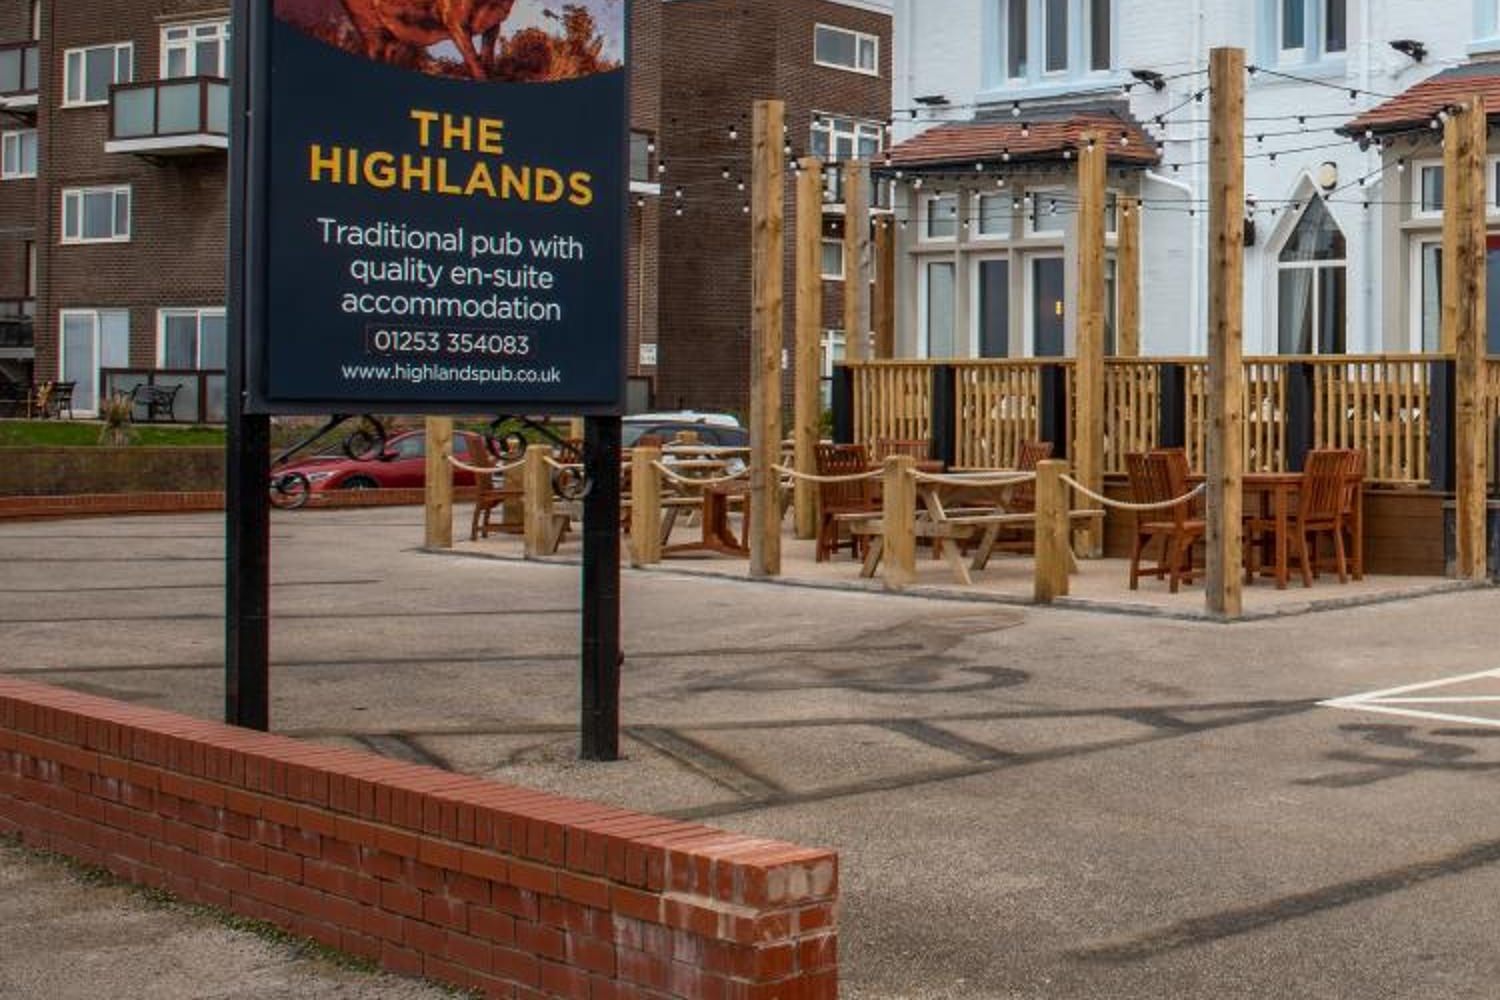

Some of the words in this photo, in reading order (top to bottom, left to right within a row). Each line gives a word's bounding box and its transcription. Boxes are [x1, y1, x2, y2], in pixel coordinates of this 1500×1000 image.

[410, 109, 504, 155] THE
[309, 144, 594, 206] HIGHLANDS
[316, 217, 464, 252] Traditional
[471, 231, 523, 259] pub
[529, 234, 584, 261] with
[350, 256, 443, 289] quality
[450, 263, 554, 290] en-suite
[341, 292, 562, 322] accommodation
[374, 330, 440, 351] 01253
[446, 333, 530, 355] 354083
[341, 363, 561, 384] www.highlandspub.co.uk
